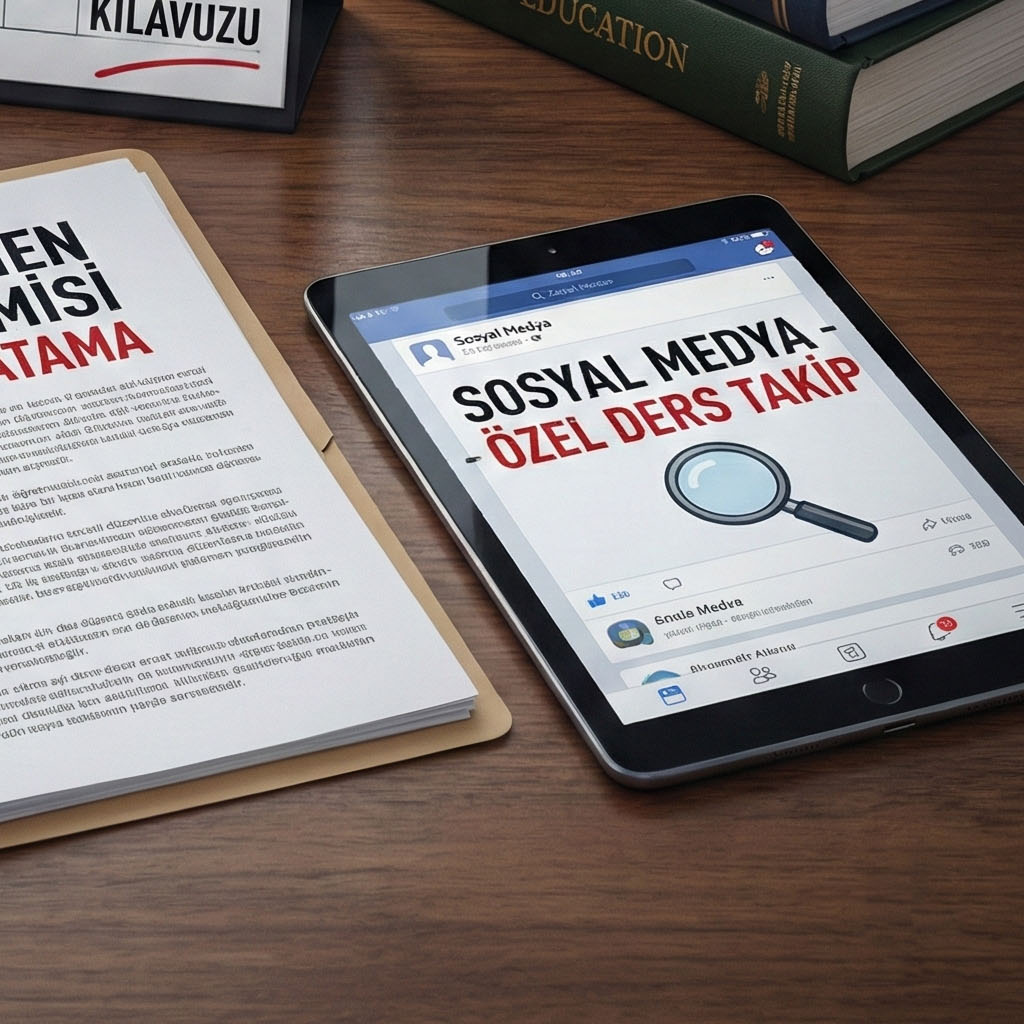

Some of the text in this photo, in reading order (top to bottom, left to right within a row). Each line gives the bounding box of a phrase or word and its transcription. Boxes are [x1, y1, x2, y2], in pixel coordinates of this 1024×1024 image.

[452, 354, 648, 424] SOSYAL
[642, 316, 816, 383] MEDYA
[481, 416, 609, 471] ÖZEL
[603, 386, 733, 444] DERS
[726, 353, 861, 415] TAKİP
